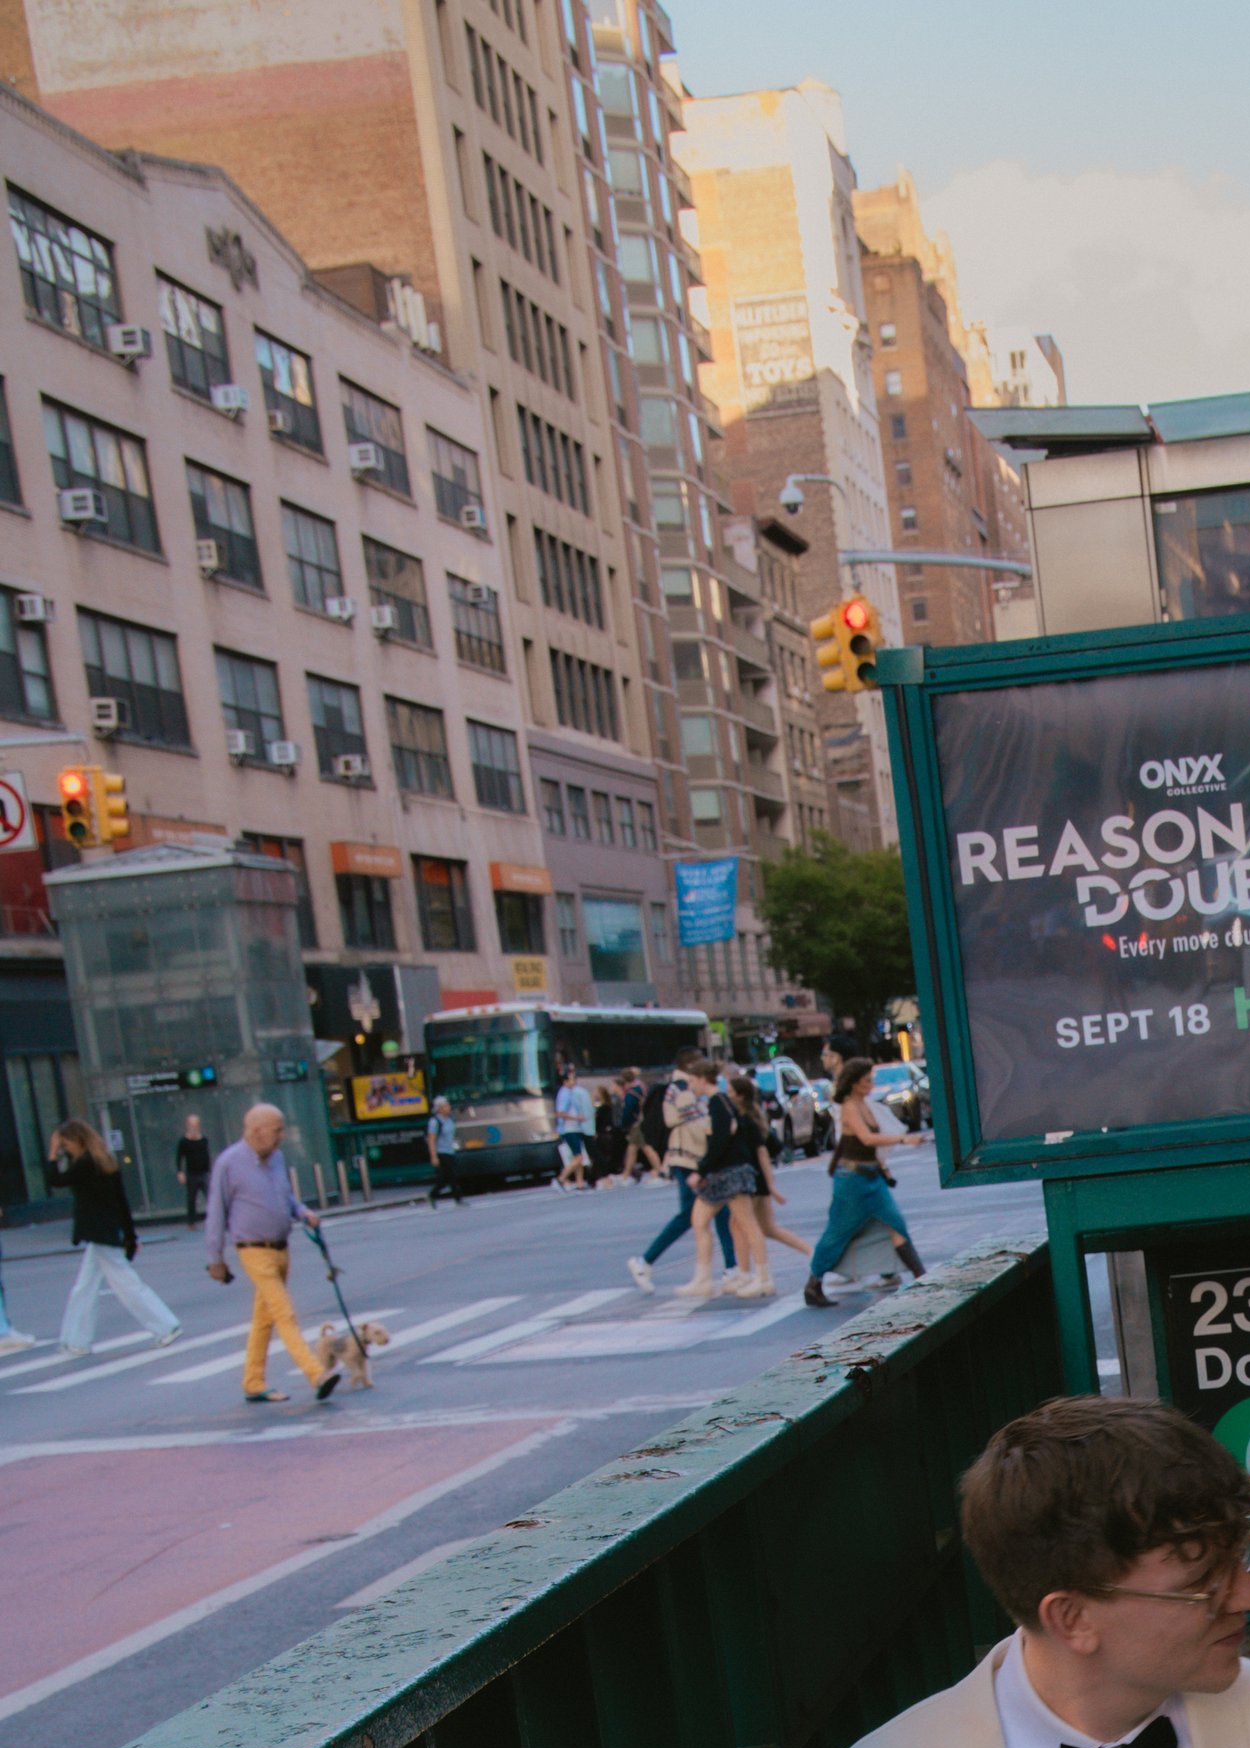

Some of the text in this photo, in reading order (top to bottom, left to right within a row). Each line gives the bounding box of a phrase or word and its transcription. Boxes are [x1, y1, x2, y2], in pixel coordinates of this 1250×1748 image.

[745, 356, 814, 385] TOYS
[1138, 752, 1226, 790] ONYX
[1166, 782, 1228, 798] COLLECTIVE
[1118, 934, 1167, 961] Every
[1172, 931, 1219, 954] move
[1056, 1008, 1154, 1048] SEPT
[1168, 1003, 1211, 1037] 18
